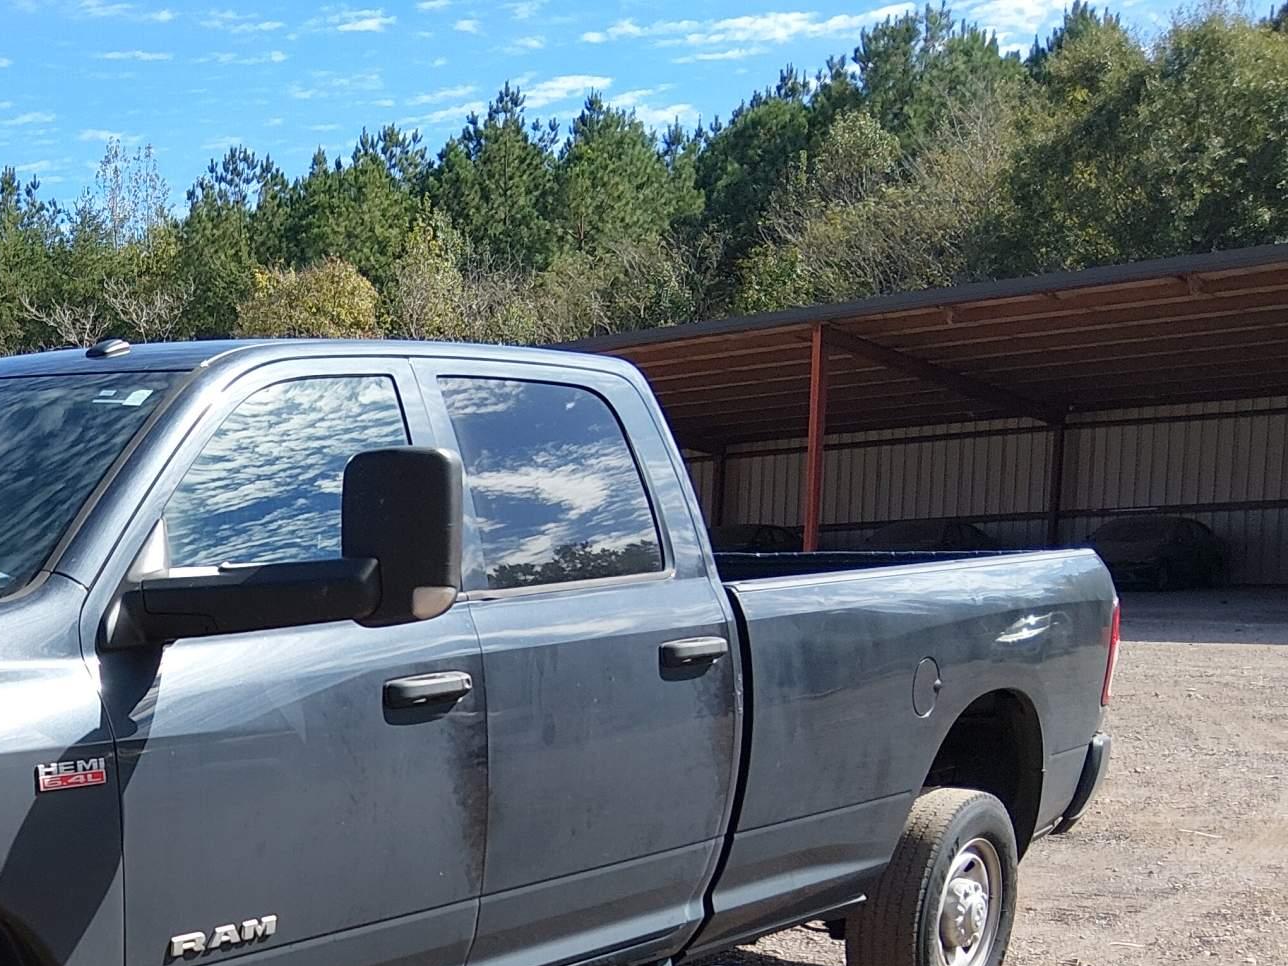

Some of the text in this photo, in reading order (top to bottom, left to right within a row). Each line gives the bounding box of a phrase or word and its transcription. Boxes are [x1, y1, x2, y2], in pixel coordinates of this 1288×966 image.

[37, 757, 106, 776] HEMI
[42, 773, 104, 788] 6.4L
[169, 914, 278, 958] RAM
